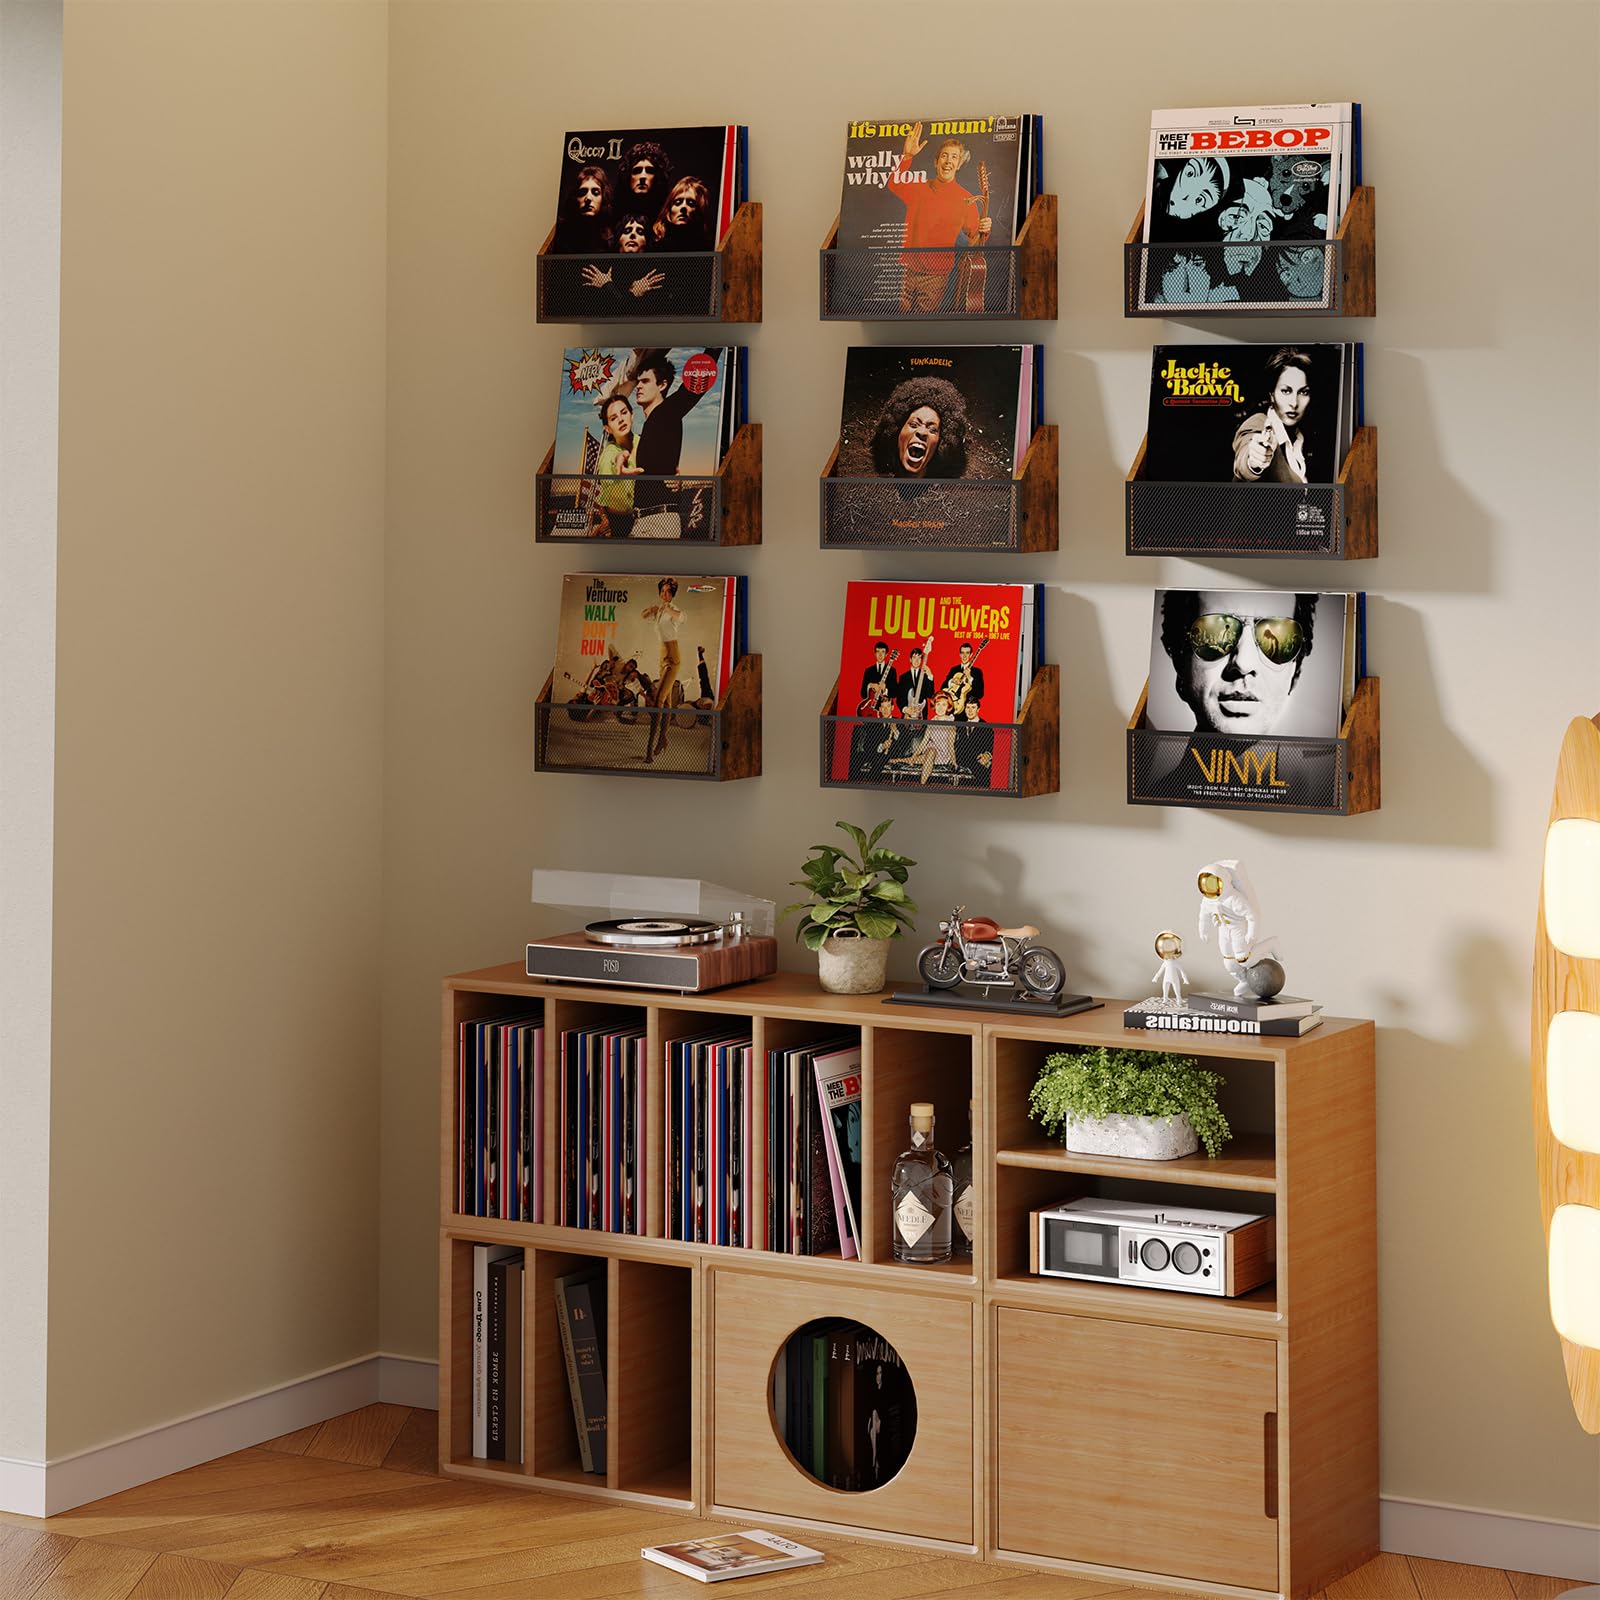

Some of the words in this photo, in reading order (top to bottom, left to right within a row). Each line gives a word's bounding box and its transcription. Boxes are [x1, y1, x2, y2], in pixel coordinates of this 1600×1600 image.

[850, 121, 876, 139] it's
[930, 115, 994, 135] mum!
[1158, 141, 1188, 151] THE
[1159, 133, 1190, 142] MEET
[1190, 128, 1331, 150] BEBOP
[568, 136, 605, 164] Queen
[606, 138, 624, 161] II
[848, 151, 905, 172] wally
[846, 167, 928, 189] whyton
[910, 357, 953, 368] FUNKADELIC
[1161, 359, 1231, 382] Jackie
[684, 369, 717, 377] exclusive
[1166, 378, 1245, 403] Brown
[592, 578, 605, 589] The
[586, 586, 629, 603] Ventures
[940, 597, 952, 605] AND
[952, 596, 962, 605] THE
[584, 604, 617, 622] WALK
[868, 595, 936, 639] LULU
[940, 604, 1010, 633] LUVVERS
[582, 621, 619, 640] DON'T
[954, 631, 965, 639] BEST
[966, 631, 972, 639] OF
[1000, 632, 1010, 640] LIVE
[580, 639, 605, 657] RUN
[1191, 748, 1287, 787] VINYL
[826, 1080, 844, 1091] MEET
[828, 1088, 845, 1100] THE
[897, 1213, 928, 1224] NEEDLE
